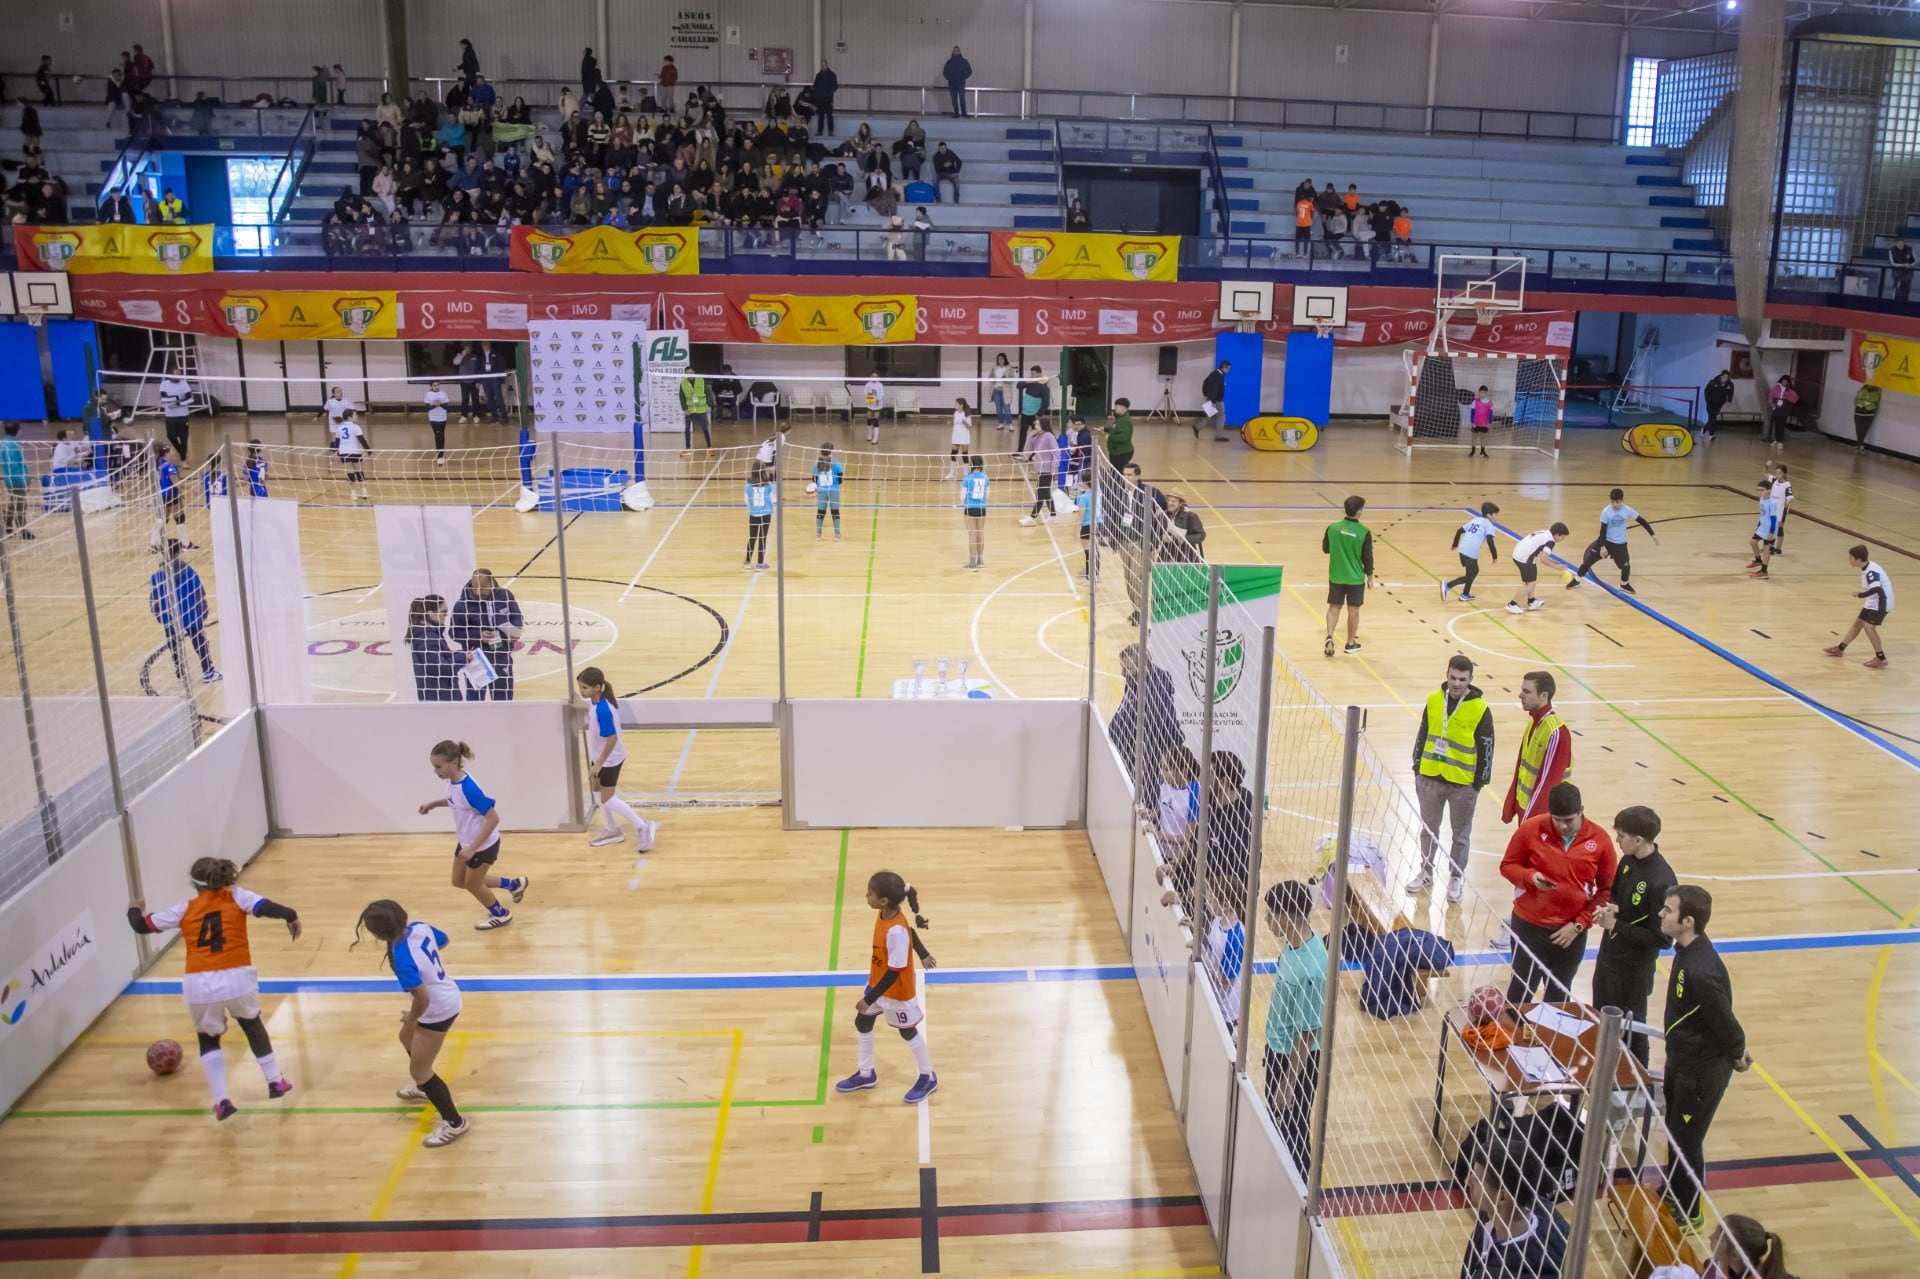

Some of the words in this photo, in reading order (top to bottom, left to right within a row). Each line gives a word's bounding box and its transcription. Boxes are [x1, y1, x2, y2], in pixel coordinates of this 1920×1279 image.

[677, 12, 711, 20] ASEOS
[447, 302, 473, 313] IMD
[572, 304, 598, 315] IMD
[698, 305, 723, 316] IMD
[940, 308, 966, 319] IMD
[1062, 309, 1087, 320] IMD
[1178, 310, 1202, 319] IMD
[1404, 321, 1428, 331] IMD
[1514, 322, 1538, 332] IMD
[341, 427, 350, 440] 3
[1467, 523, 1480, 534] 16
[197, 911, 227, 953] 4
[420, 936, 446, 980] 5
[896, 1011, 908, 1024] 19
